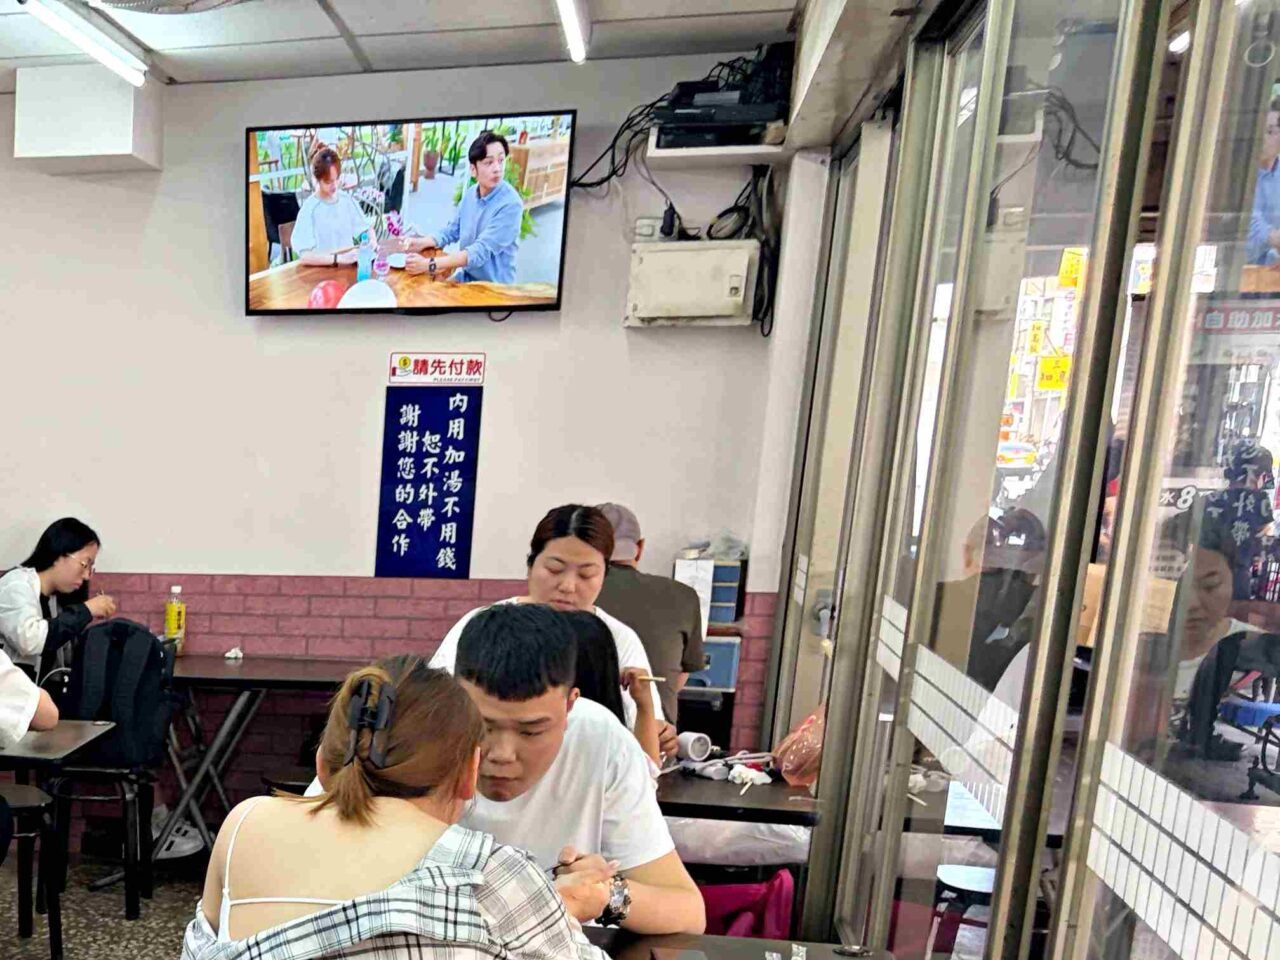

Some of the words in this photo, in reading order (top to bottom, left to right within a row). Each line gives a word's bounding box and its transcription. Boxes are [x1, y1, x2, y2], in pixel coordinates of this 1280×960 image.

[412, 358, 483, 376] 請先付款
[392, 403, 421, 557] 謝謝您的合作
[417, 430, 442, 532] 恕不外帶
